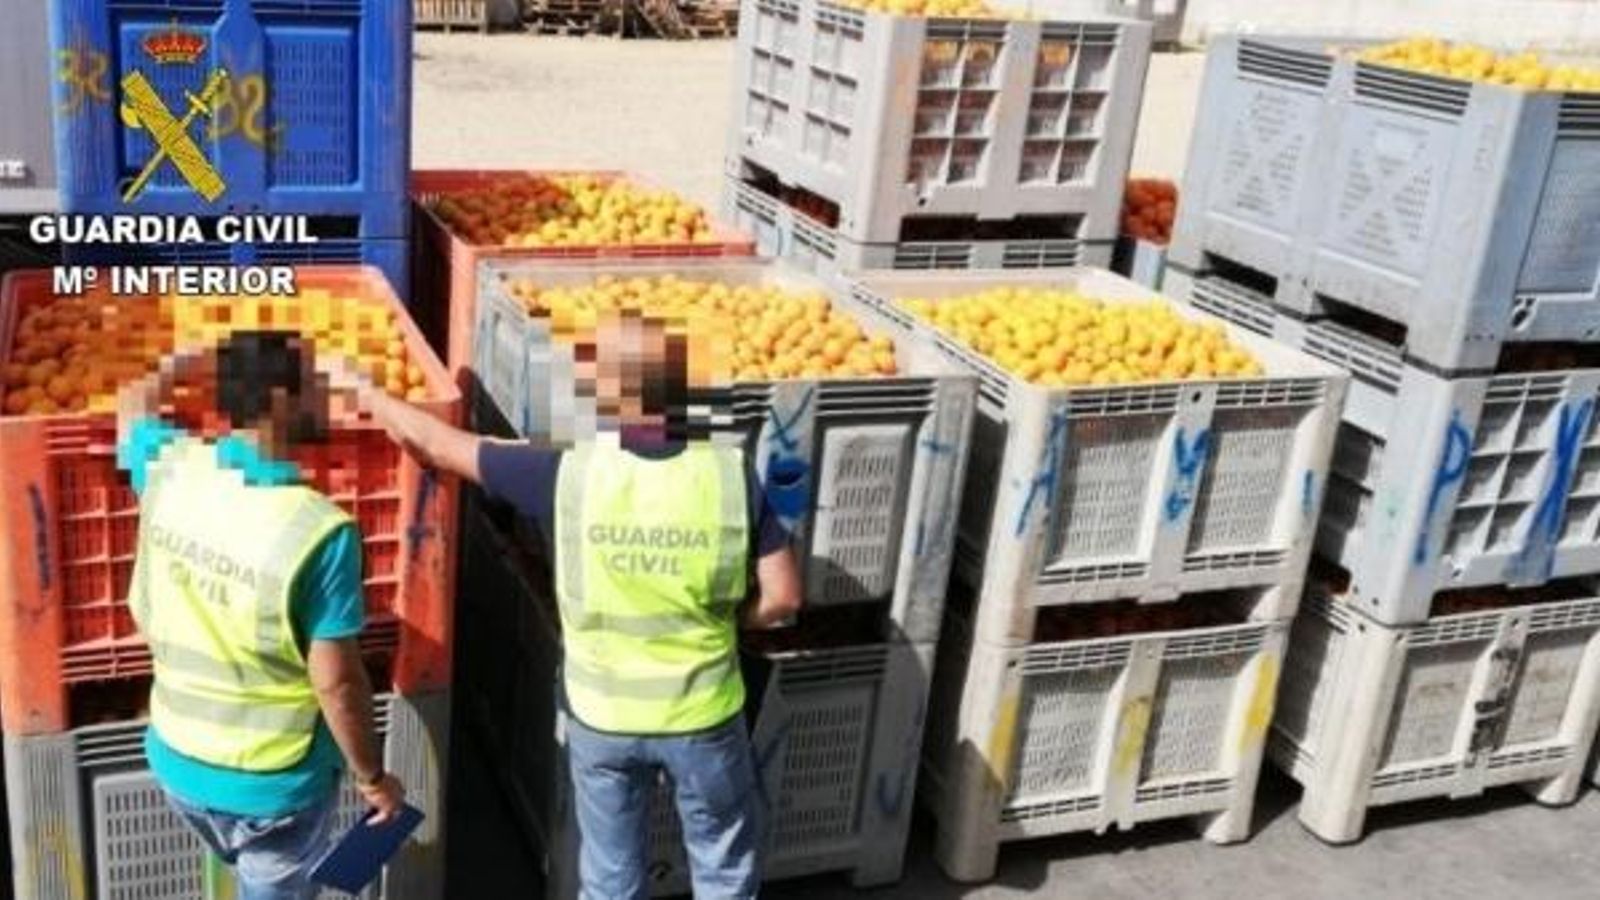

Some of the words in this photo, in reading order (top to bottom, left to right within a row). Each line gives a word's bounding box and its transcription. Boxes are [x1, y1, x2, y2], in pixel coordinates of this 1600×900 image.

[586, 523, 710, 549] GUARDIA
[149, 524, 256, 592] GUARDIA
[608, 551, 683, 577] CIVIL
